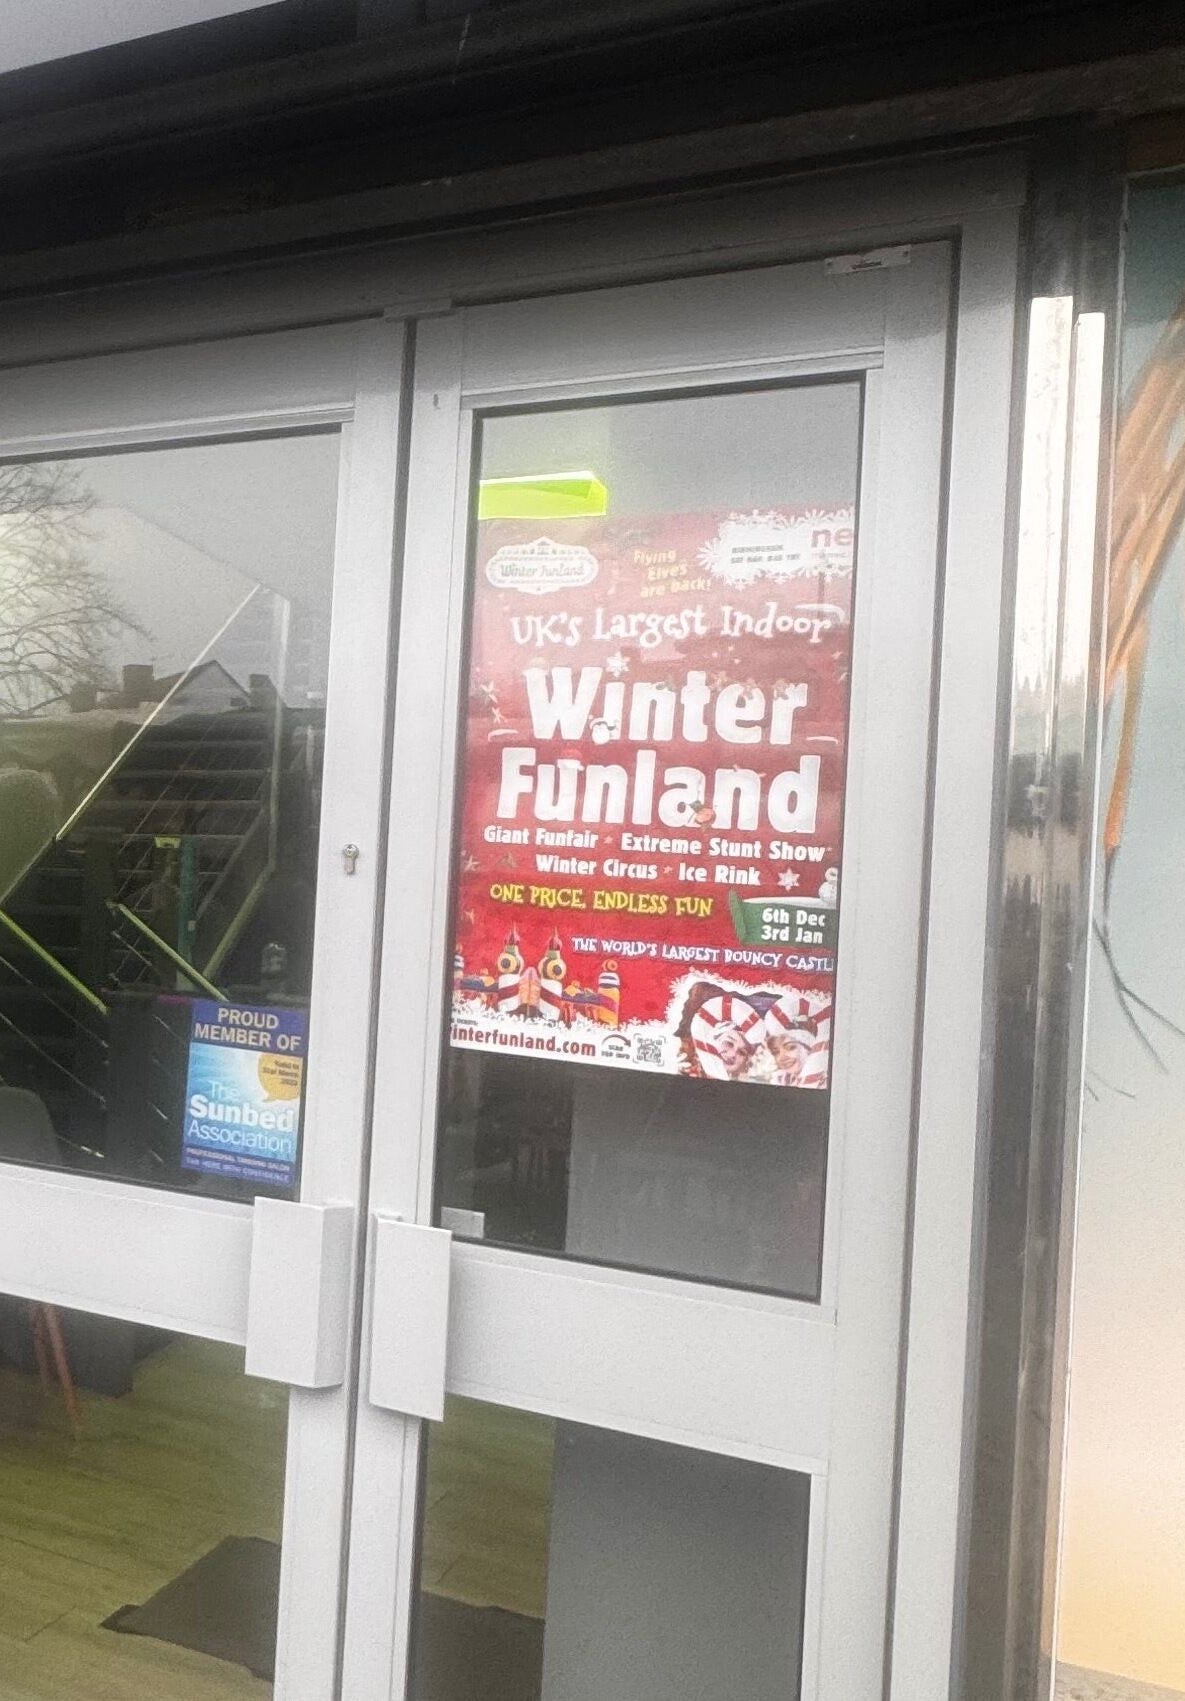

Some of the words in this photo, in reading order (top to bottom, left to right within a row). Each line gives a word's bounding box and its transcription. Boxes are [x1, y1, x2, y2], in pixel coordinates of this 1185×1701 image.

[640, 585, 666, 598] are
[510, 612, 583, 647] UK's
[592, 605, 706, 649] Largest
[719, 601, 833, 644] Indoor
[522, 665, 809, 746] Winter
[496, 747, 822, 834] Funland
[483, 825, 529, 846] Giant
[535, 828, 598, 849] Funfair
[620, 832, 702, 855] Extreme
[708, 837, 762, 859] Stunt
[769, 841, 826, 863] Show
[535, 854, 597, 875] Winter
[603, 858, 658, 880] Circus
[678, 862, 707, 882] Ice
[714, 864, 761, 886] Rink
[489, 884, 524, 904] ONE
[593, 890, 668, 915] ENDLESS
[674, 896, 713, 917] FUN
[761, 907, 790, 926] 6th
[795, 909, 826, 927] Dec
[760, 925, 790, 942] 3rd
[795, 927, 823, 944] Jan
[571, 937, 597, 953] THE
[600, 940, 657, 957] WORLD'S
[661, 944, 719, 962] LARGEST
[724, 949, 783, 967] BOUNCY
[217, 1007, 279, 1030] PROUD
[194, 1023, 271, 1048] MEMBER
[276, 1034, 302, 1051] OF
[449, 1024, 596, 1057] interfunland.com
[209, 1080, 239, 1099] The
[189, 1094, 294, 1132] Sunbed
[187, 1119, 293, 1153] Association
